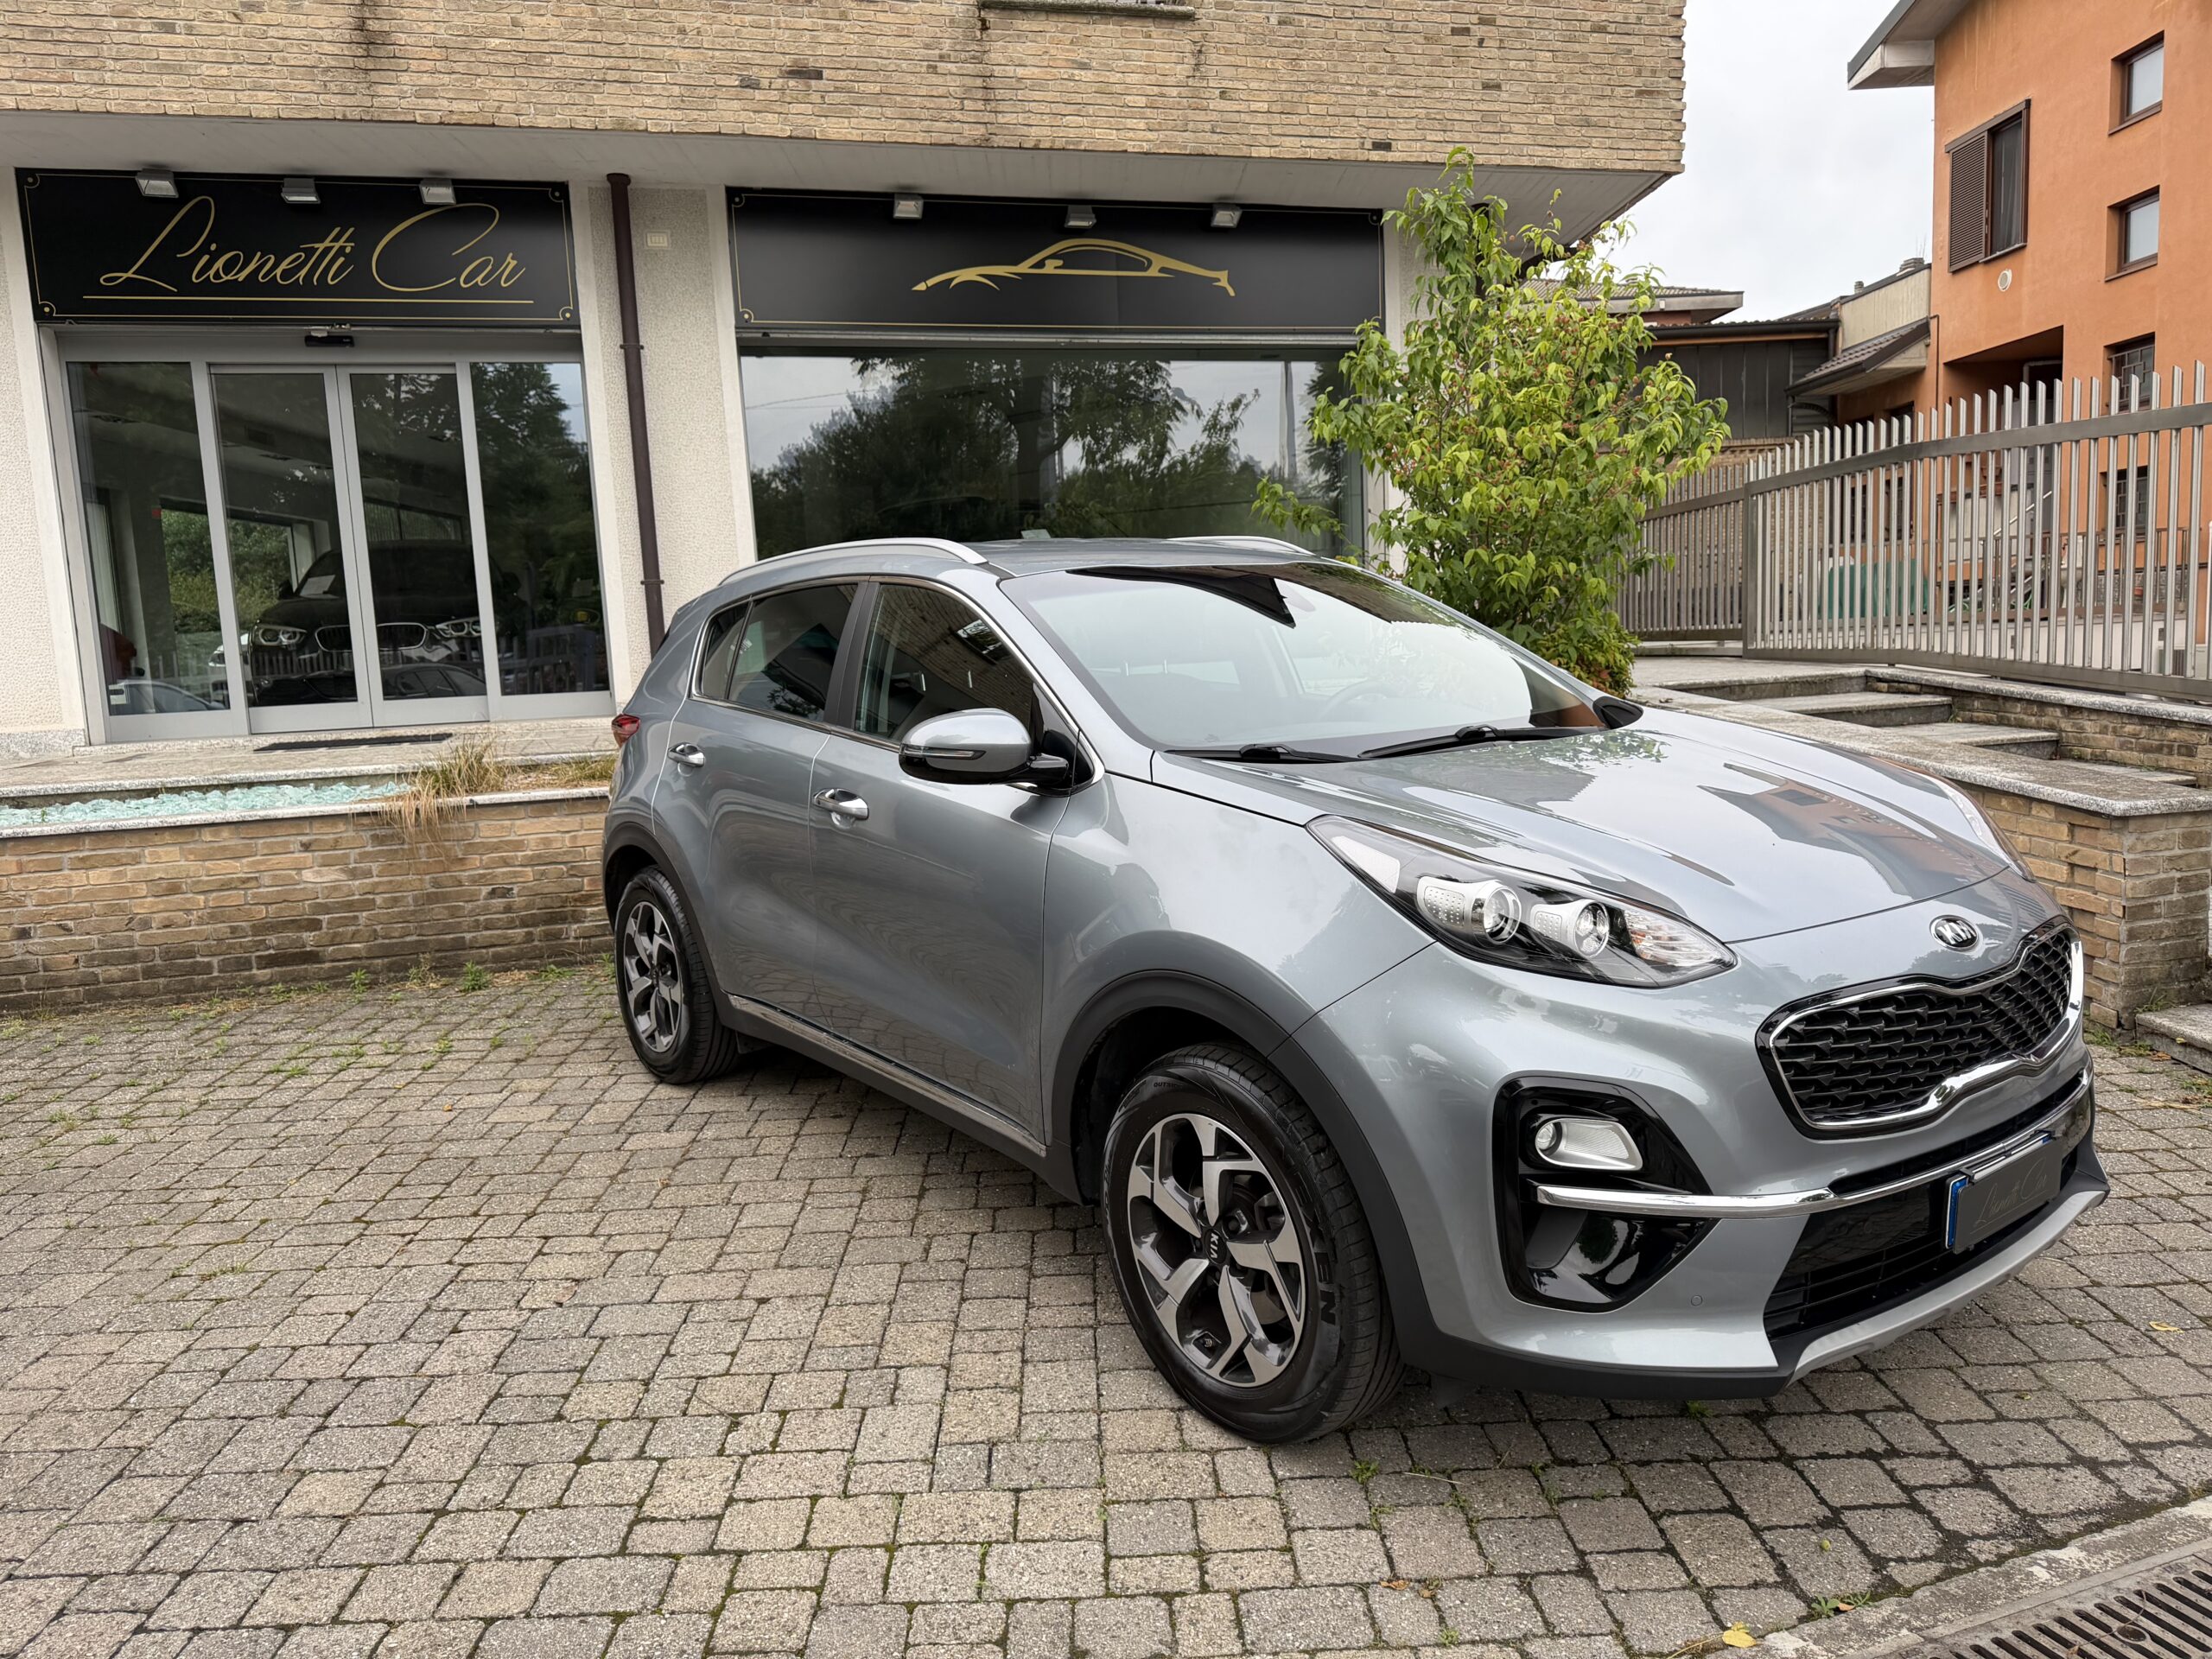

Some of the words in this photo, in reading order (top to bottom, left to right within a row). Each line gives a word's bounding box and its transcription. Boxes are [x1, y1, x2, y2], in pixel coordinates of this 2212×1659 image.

[99, 196, 355, 292] Lionetti
[372, 203, 525, 292] Car
[1937, 920, 1977, 944] KIA
[1210, 1232, 1218, 1259] KIA
